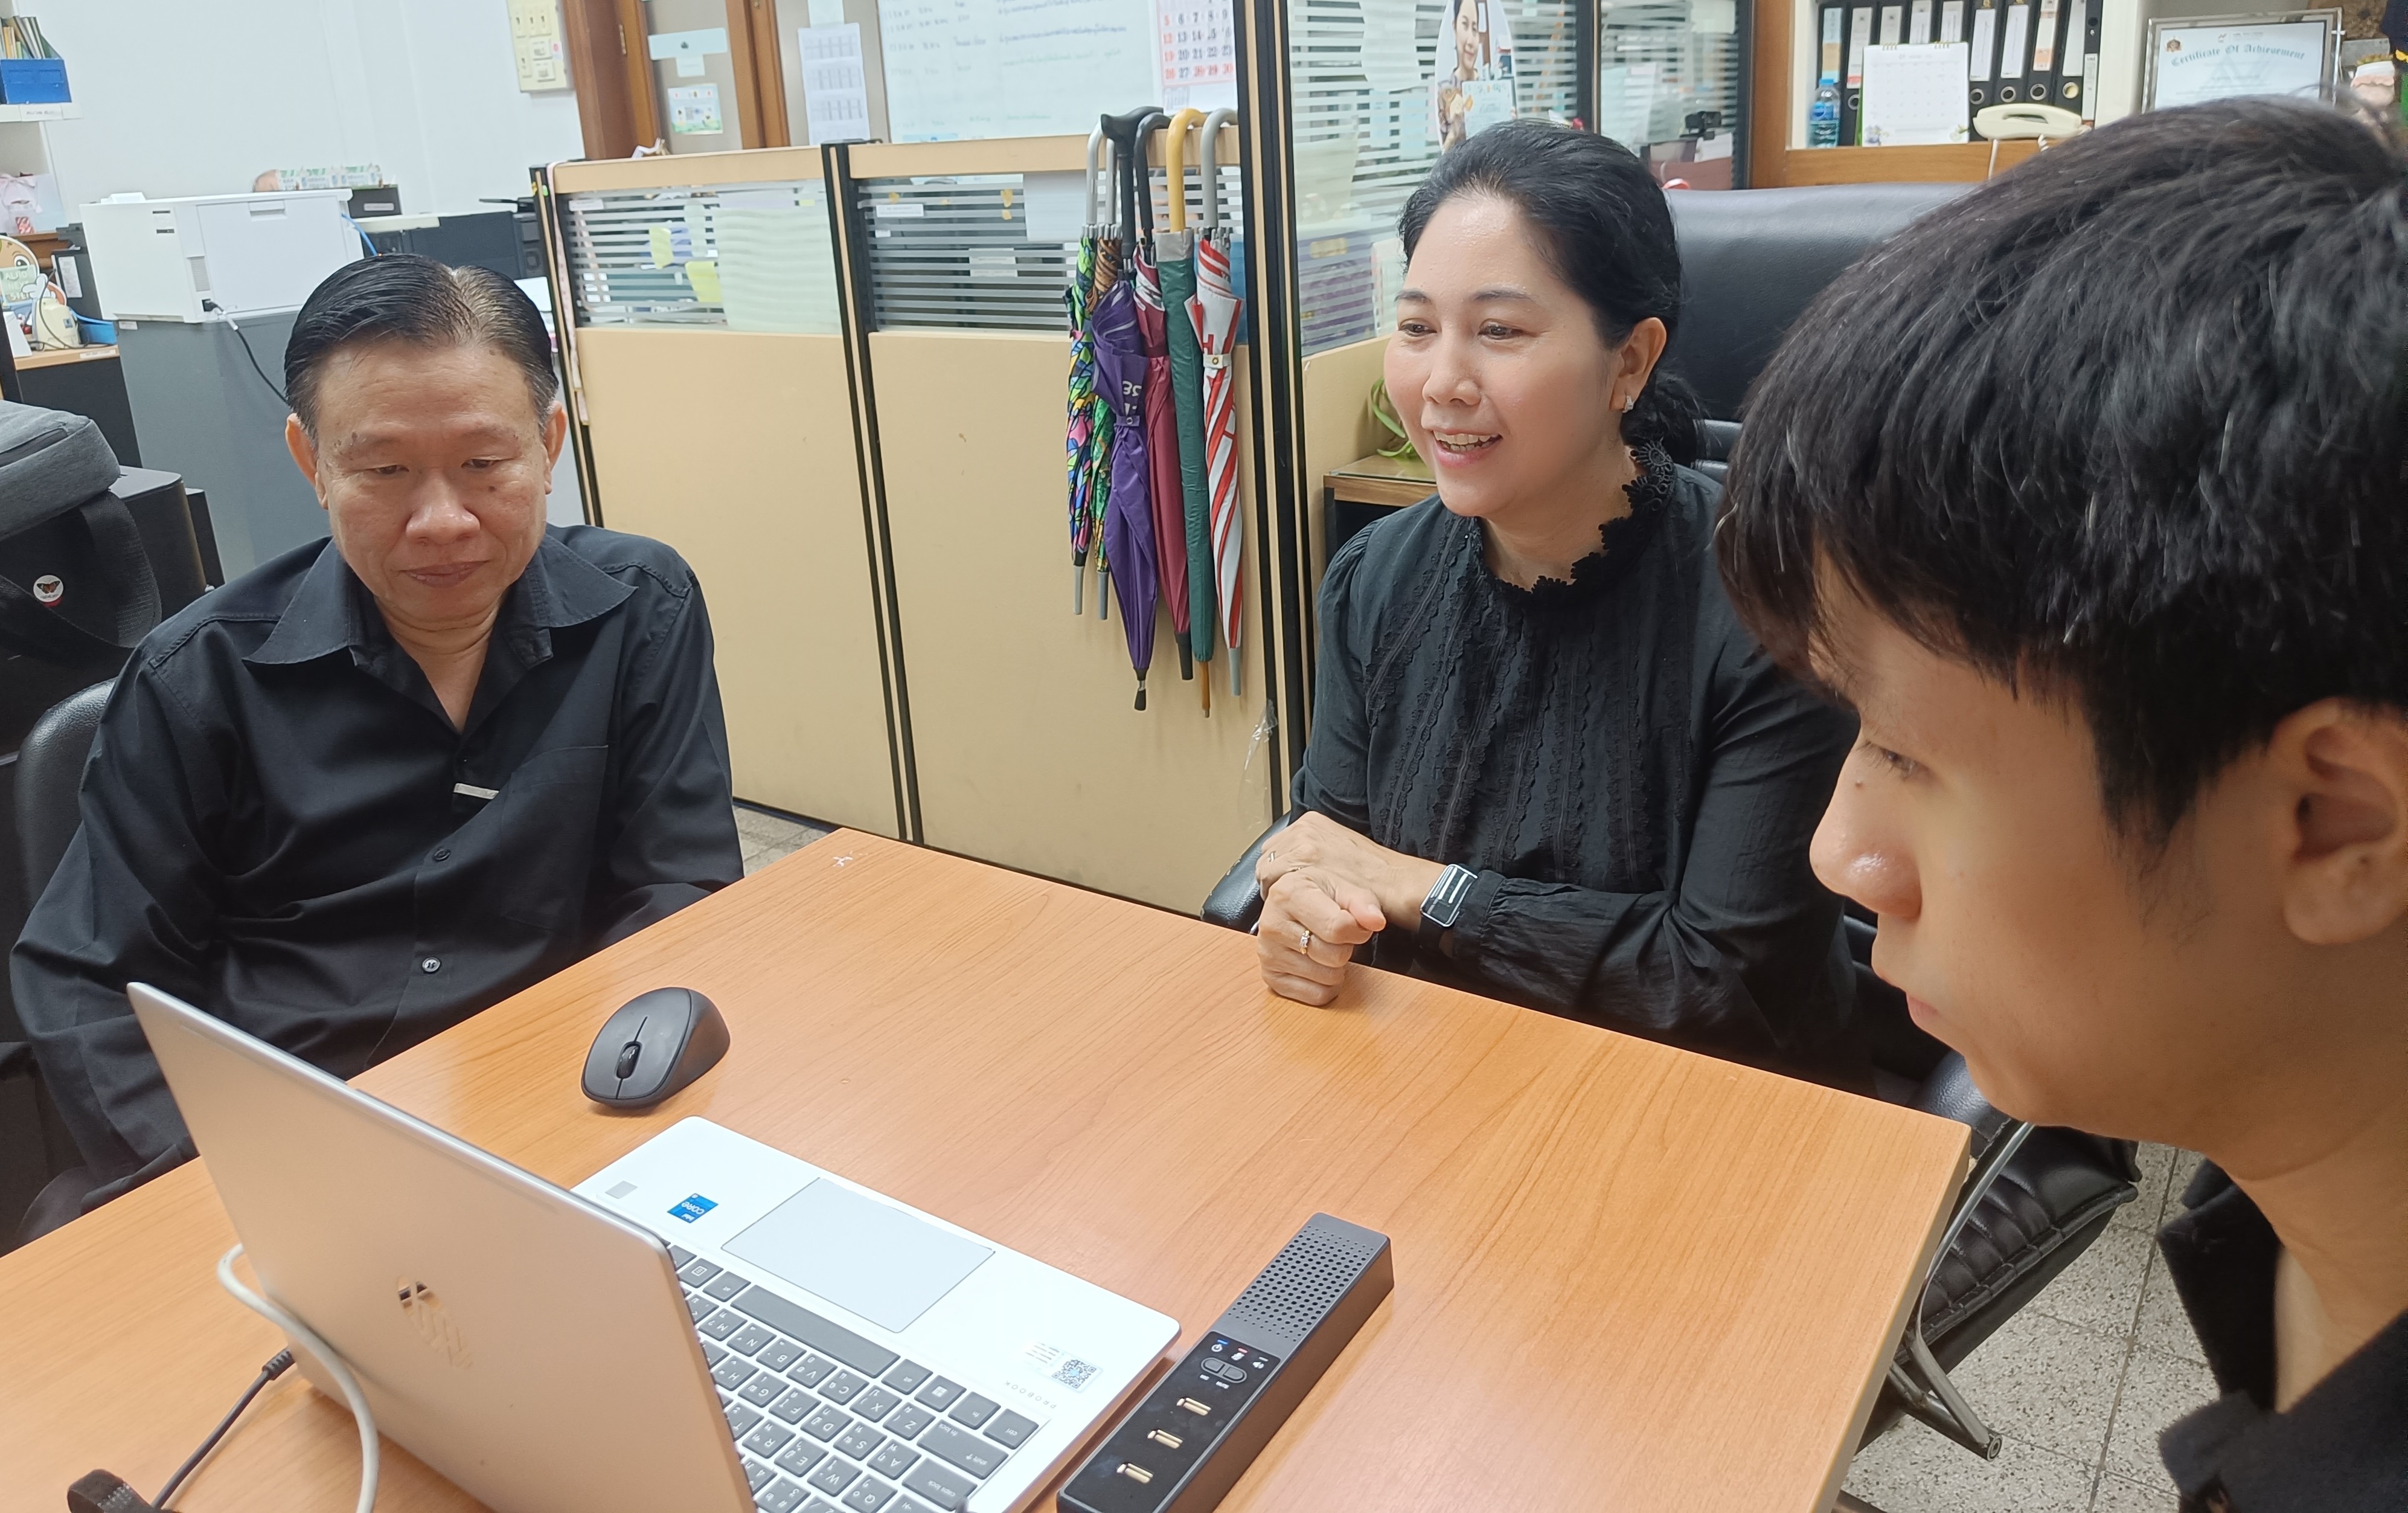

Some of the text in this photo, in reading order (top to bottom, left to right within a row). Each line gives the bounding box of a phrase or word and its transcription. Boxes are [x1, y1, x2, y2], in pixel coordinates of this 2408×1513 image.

[2171, 43, 2305, 66] Certificate Of Achievement
[746, 1338, 758, 1347] N
[777, 1354, 788, 1363] B
[728, 1372, 740, 1381] H
[806, 1370, 817, 1379] V
[1004, 1380, 1057, 1409] PROBOOK
[871, 1402, 883, 1412] X
[822, 1423, 834, 1431] D
[905, 1420, 917, 1430] Z
[764, 1438, 776, 1447] R
[856, 1441, 867, 1449] S
[796, 1456, 809, 1466] E
[890, 1457, 902, 1467] A
[825, 1474, 841, 1485] W
[864, 1494, 876, 1504] Q
